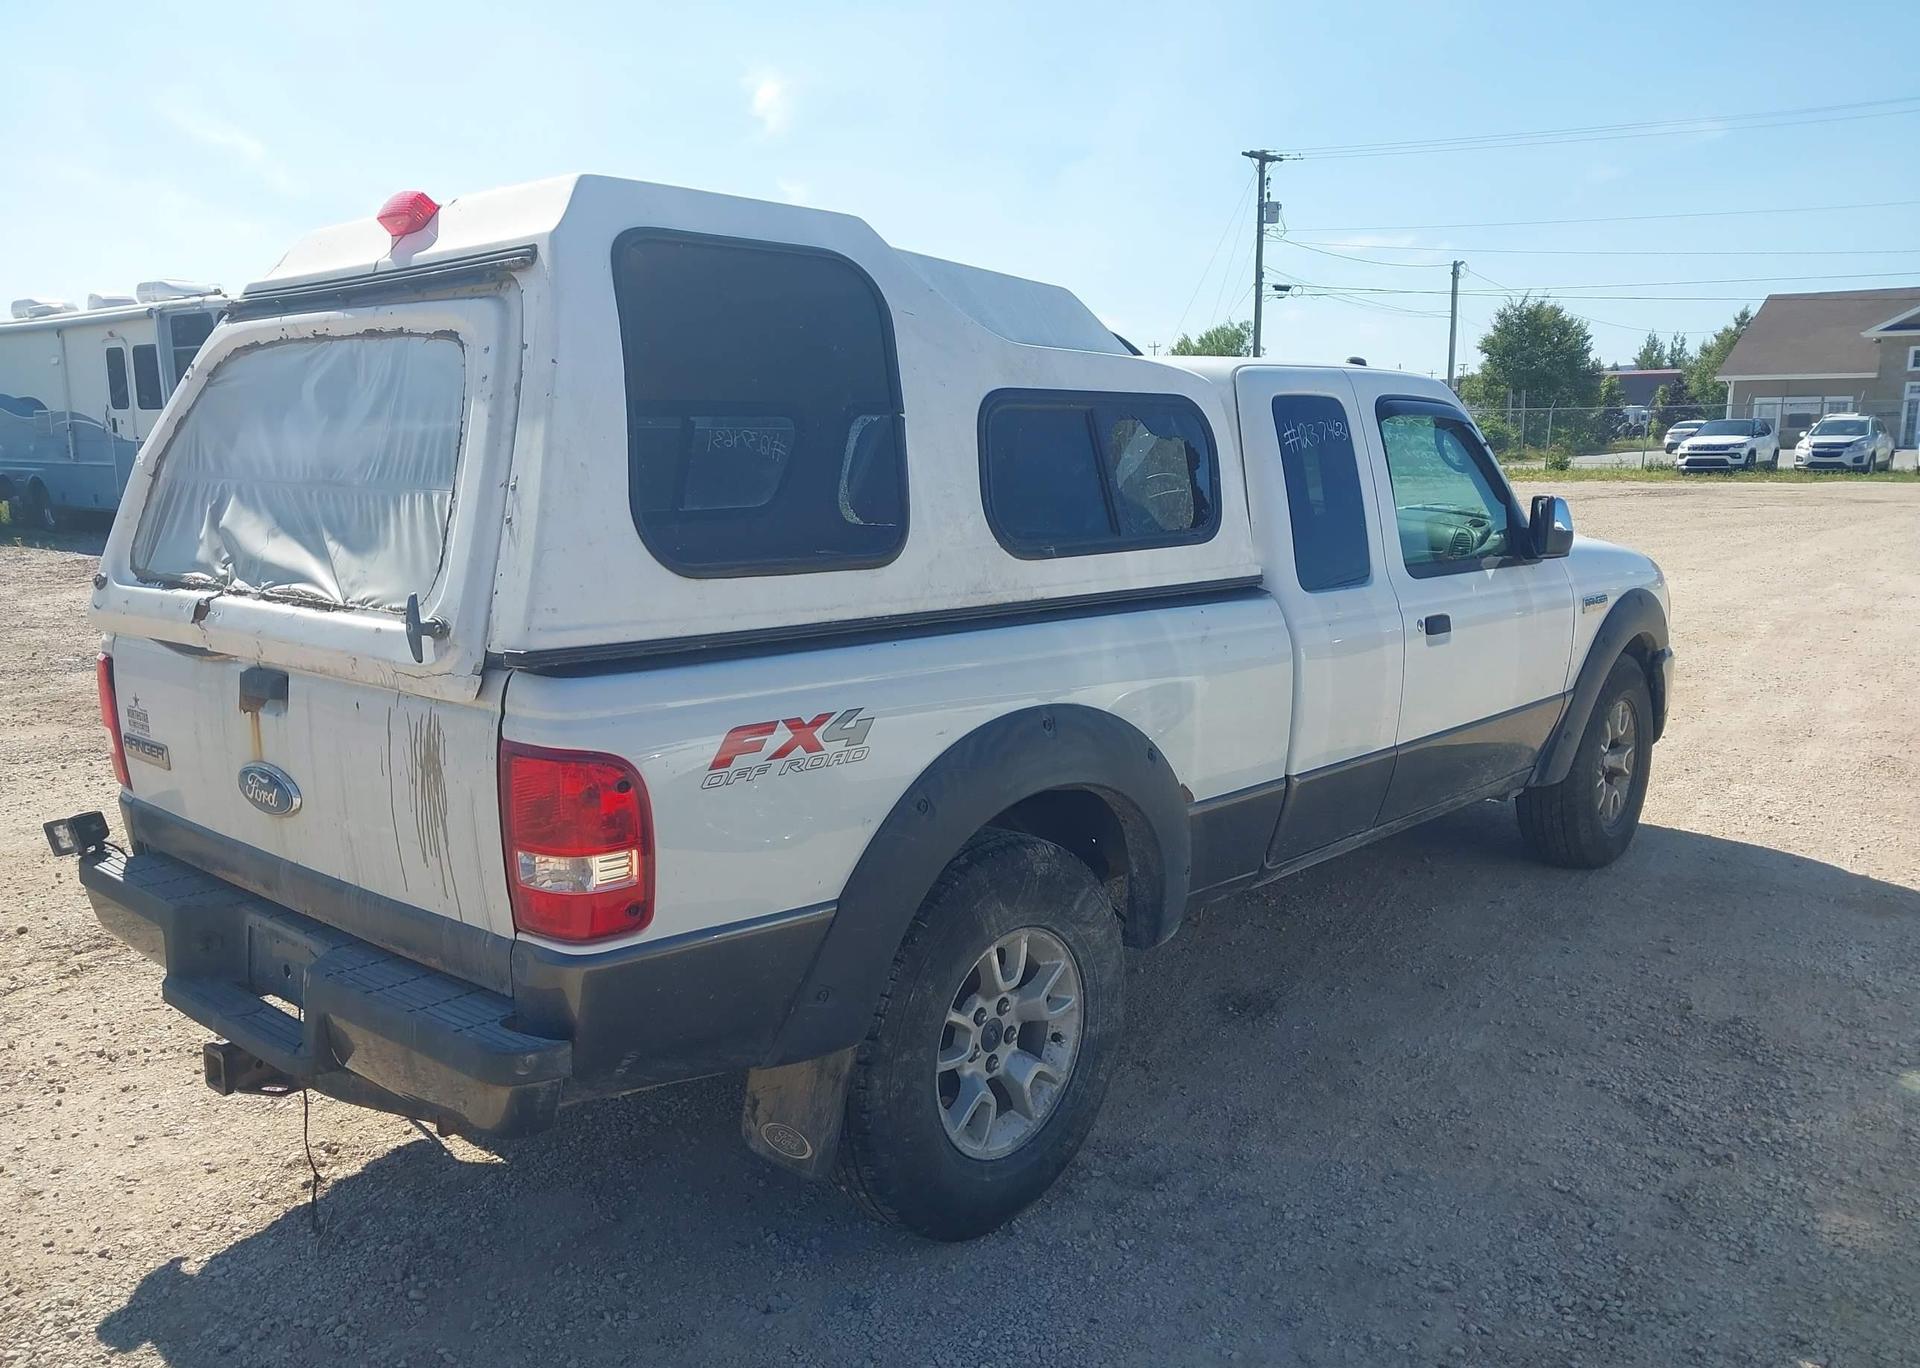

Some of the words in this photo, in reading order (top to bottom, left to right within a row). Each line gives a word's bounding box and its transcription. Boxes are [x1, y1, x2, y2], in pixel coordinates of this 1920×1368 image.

[123, 734, 166, 761] RANGER
[707, 706, 875, 771] FX4
[701, 763, 772, 789] OFF
[778, 746, 870, 776] ROAD
[245, 772, 278, 808] Ford
